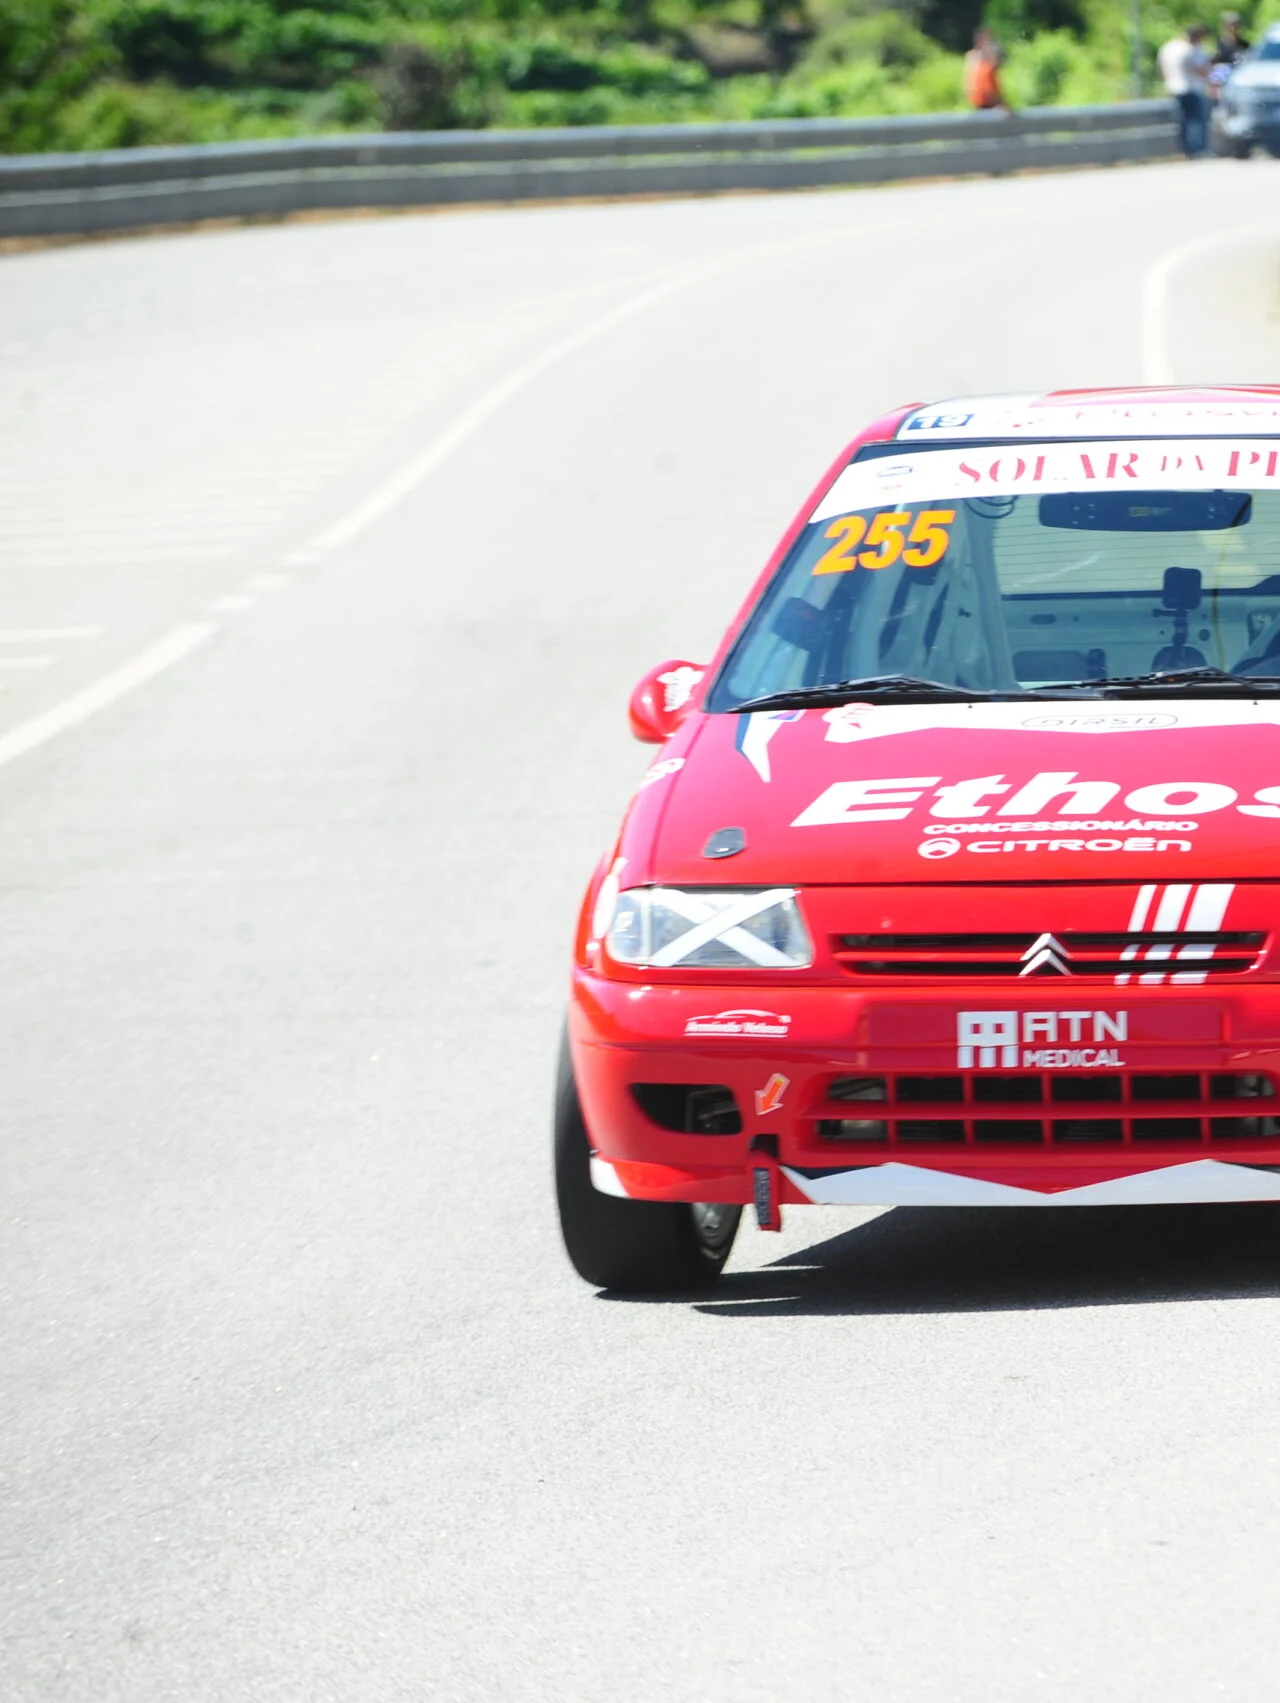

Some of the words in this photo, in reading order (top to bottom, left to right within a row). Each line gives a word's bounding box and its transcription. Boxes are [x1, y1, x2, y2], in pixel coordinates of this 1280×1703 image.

[956, 451, 1140, 486] SOLAR
[811, 510, 957, 576] 255
[922, 819, 1199, 835] CONCESSIONÁRIO
[1023, 1011, 1128, 1042] ATN
[1023, 1049, 1126, 1067] MEDICAL
